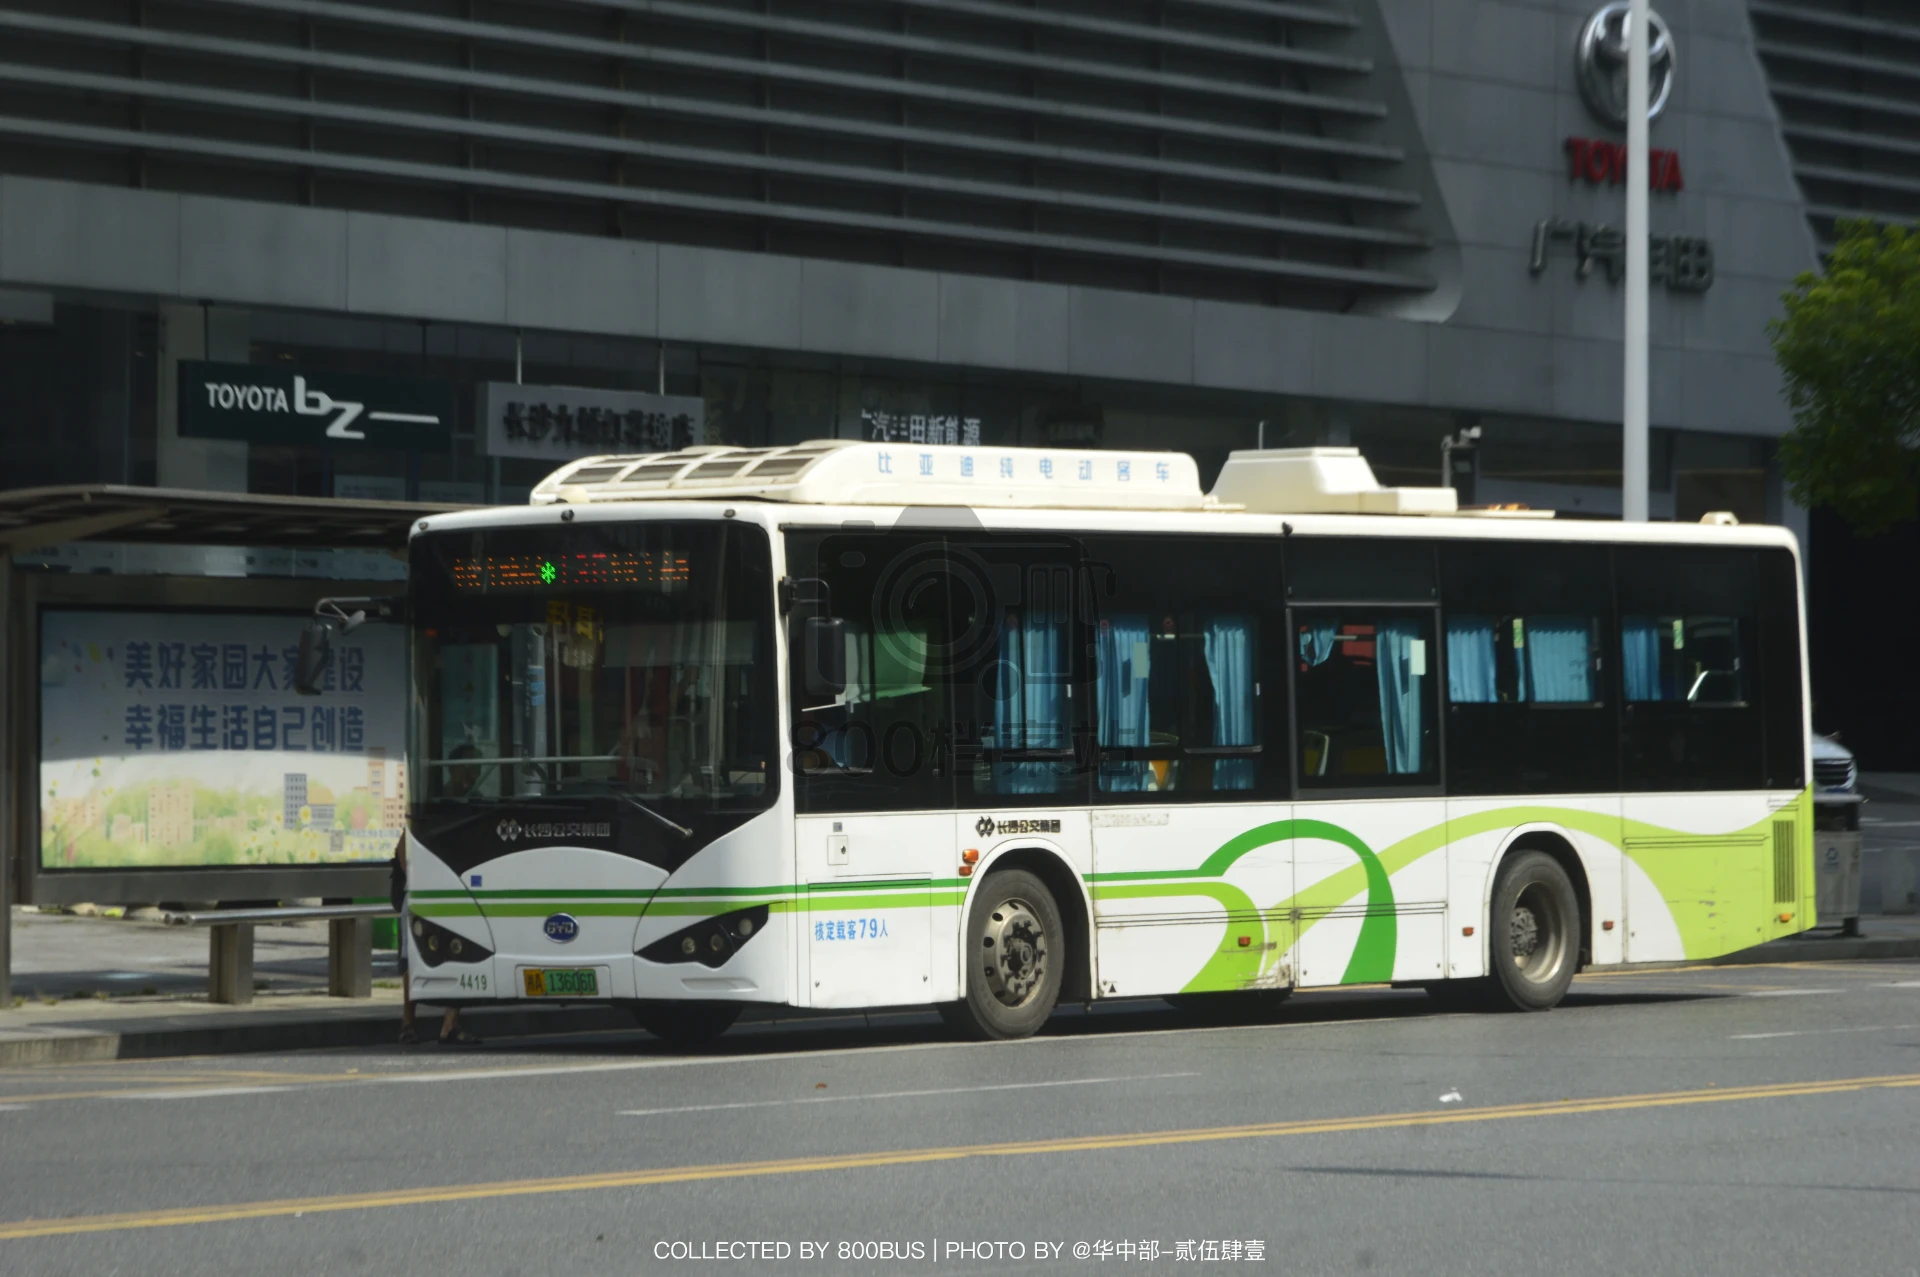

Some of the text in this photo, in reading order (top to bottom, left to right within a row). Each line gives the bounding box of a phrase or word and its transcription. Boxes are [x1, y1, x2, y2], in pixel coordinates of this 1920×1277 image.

[1566, 137, 1683, 191] TOYTA
[205, 381, 289, 413] TOYOTA
[878, 451, 1170, 482] 比亚迪纯电动客车
[125, 704, 365, 751] 幸福生活自己创造
[814, 918, 888, 941] 核定载客79人
[460, 973, 487, 991] 4419
